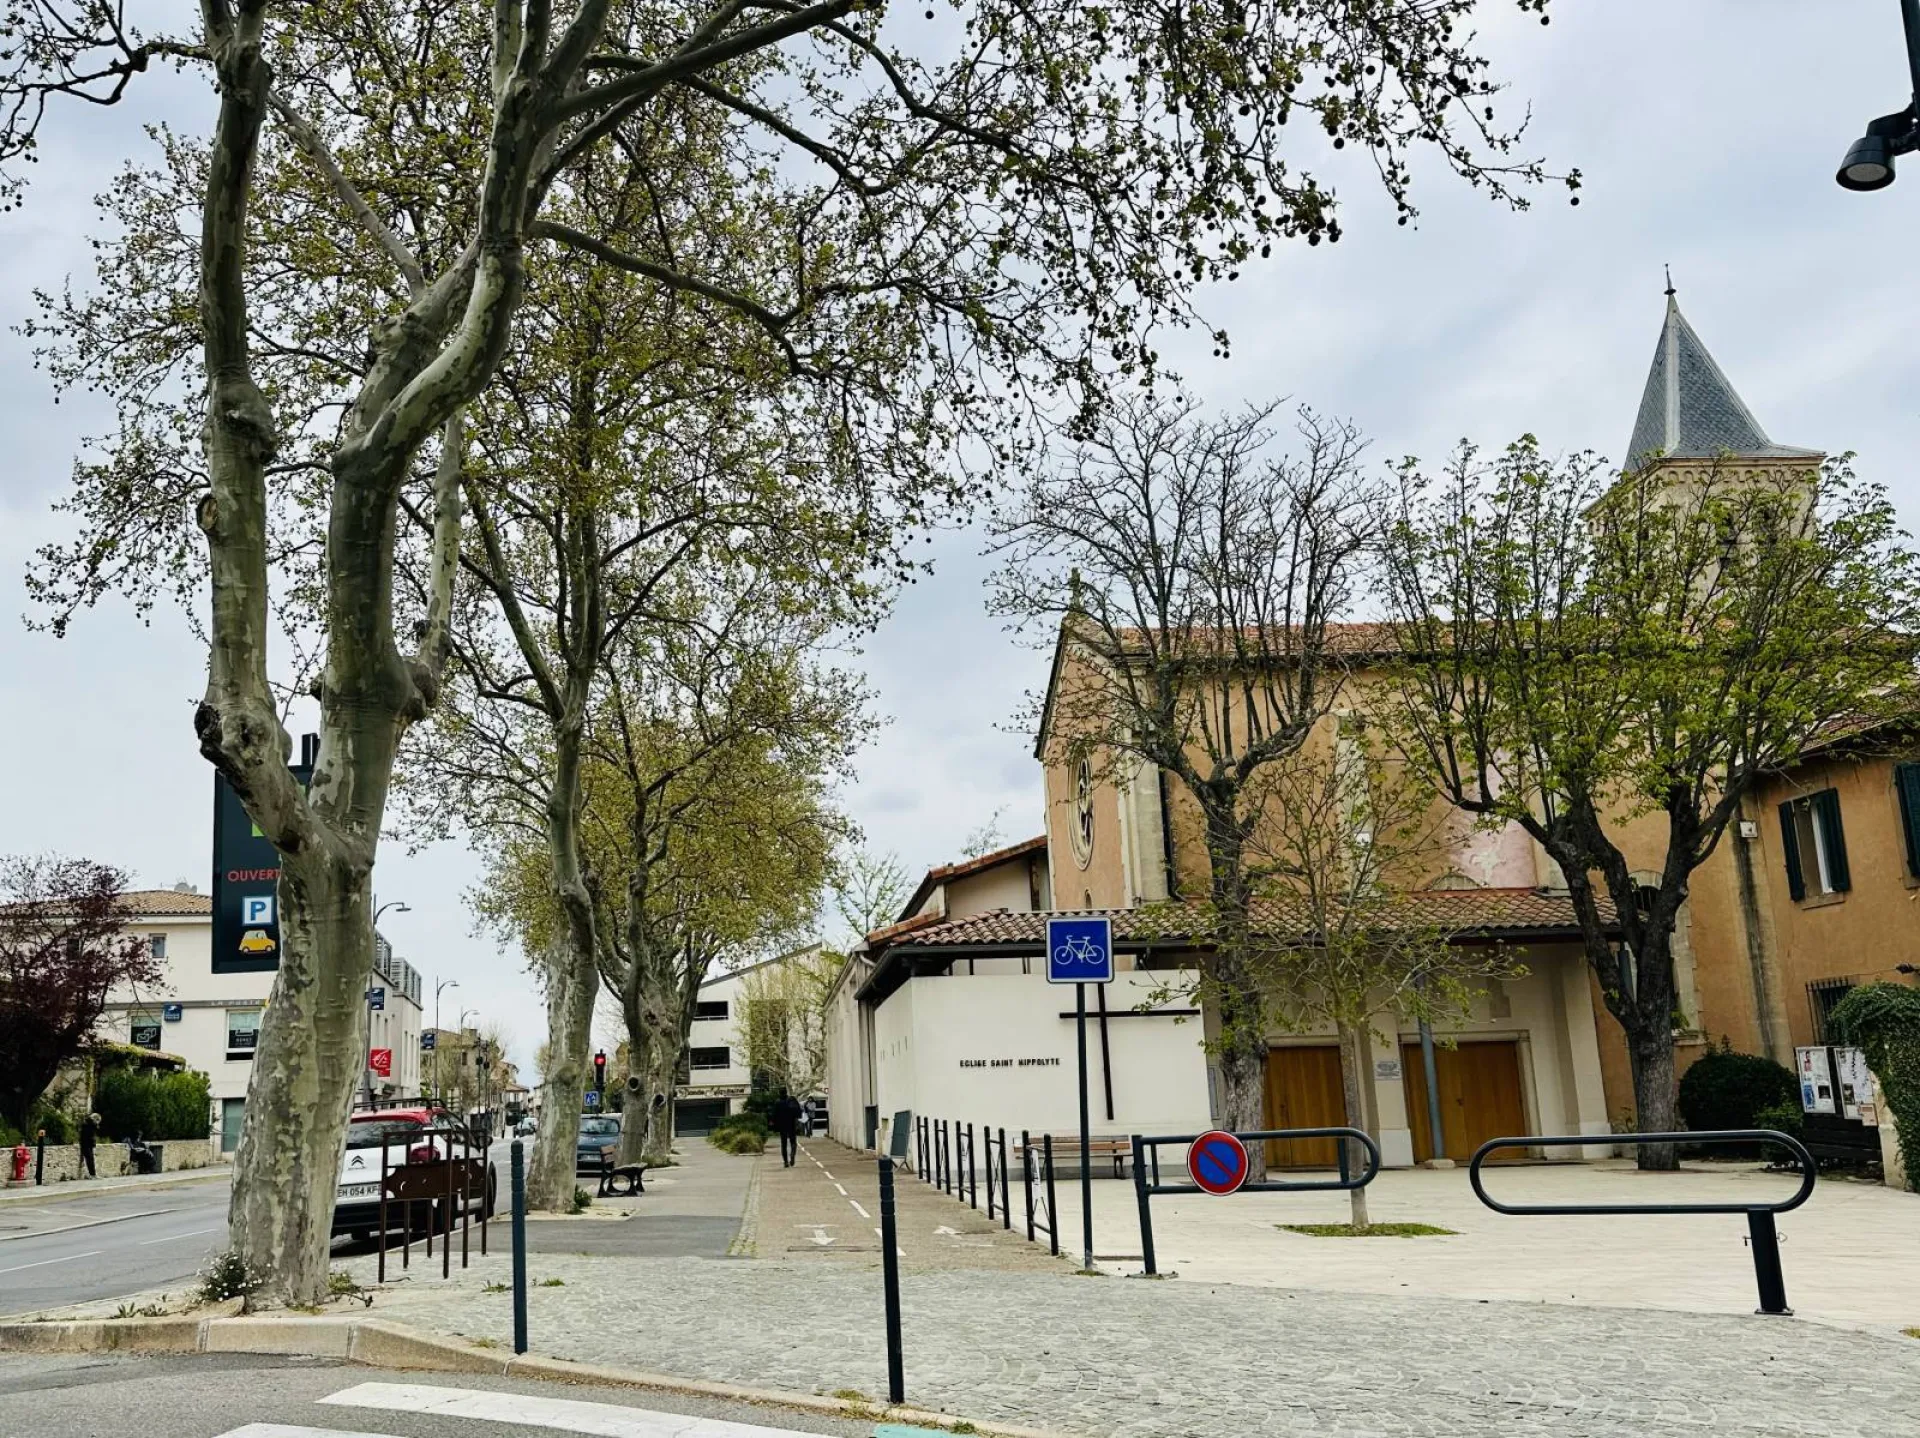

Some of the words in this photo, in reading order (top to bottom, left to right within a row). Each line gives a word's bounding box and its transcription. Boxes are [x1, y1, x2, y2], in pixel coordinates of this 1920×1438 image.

[250, 901, 266, 921] P
[990, 1059, 1013, 1067] SAINT
[1018, 1058, 1060, 1066] HIPPOLYTE
